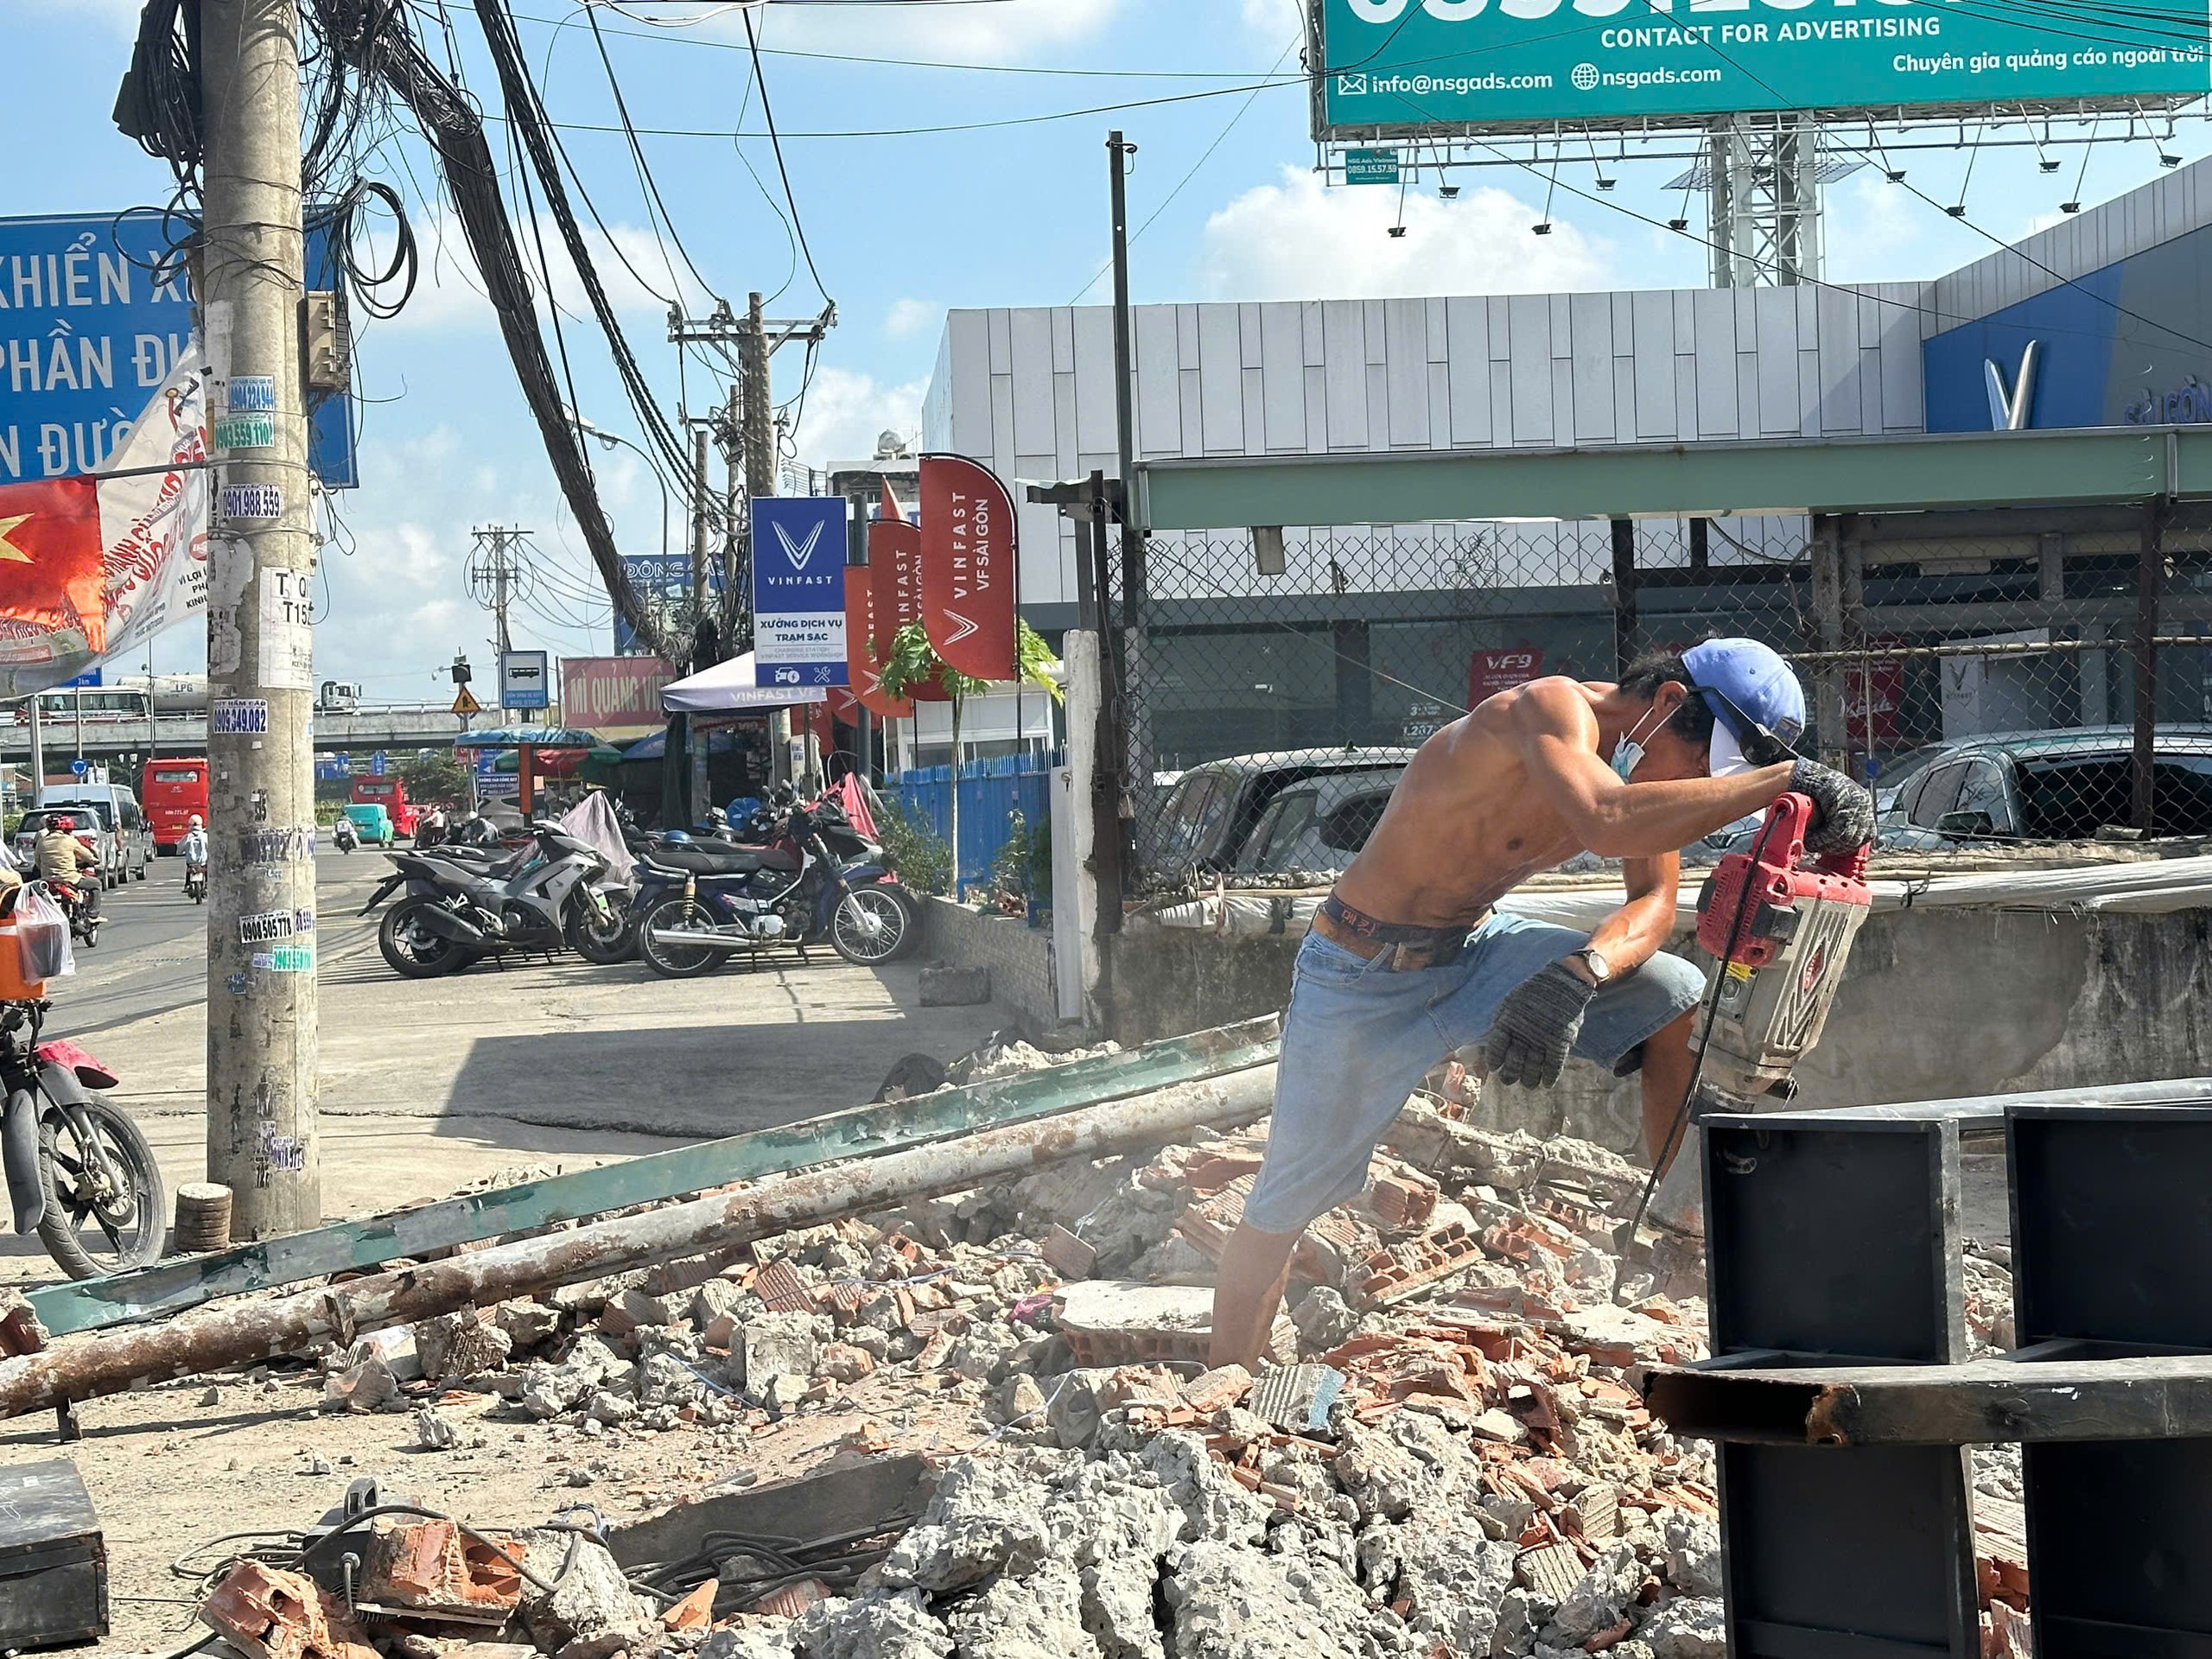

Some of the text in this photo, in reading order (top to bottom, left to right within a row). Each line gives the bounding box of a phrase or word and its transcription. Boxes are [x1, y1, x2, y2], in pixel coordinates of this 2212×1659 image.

[1600, 16, 1941, 48] CONTACT FOR ADVERTISING
[1892, 51, 1964, 75] Chuyên
[1969, 54, 2000, 75] gia
[2005, 48, 2068, 73] quảng
[2072, 48, 2107, 67] cáo
[2112, 48, 2166, 68] ngoài
[1372, 72, 1553, 95] info@nsgads.com
[1602, 67, 1721, 88] nsgads.com
[951, 492, 968, 599] VINFAST
[768, 575, 833, 585] VINFAST
[895, 550, 911, 622] INFAST
[976, 570, 990, 591] VF
[801, 620, 825, 629] DỊCH
[828, 620, 842, 629] VỤ
[775, 633, 828, 643] TRẠM SẠC
[730, 689, 794, 702] VINFAST
